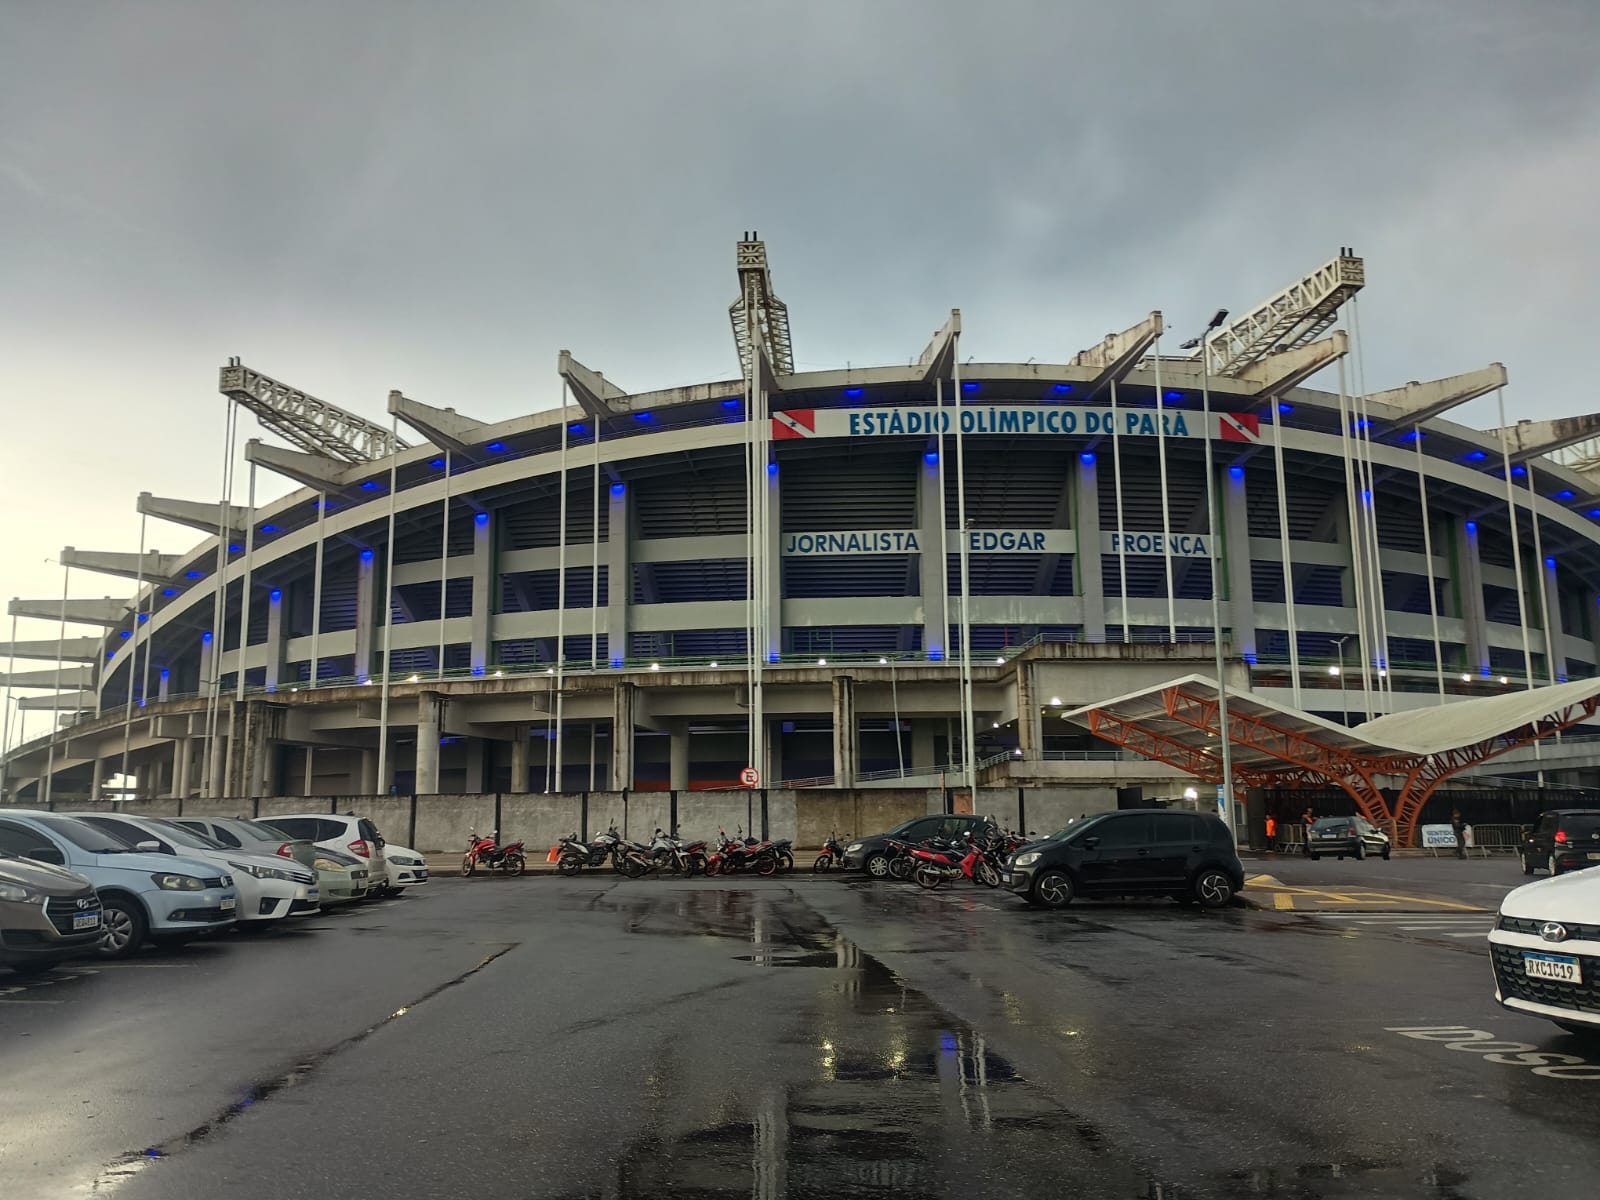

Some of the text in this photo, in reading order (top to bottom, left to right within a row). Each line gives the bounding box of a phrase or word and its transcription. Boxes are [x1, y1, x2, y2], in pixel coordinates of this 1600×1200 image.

[849, 407, 1189, 436] ESTÁDIO OLÍMPICO DO PARÁ
[786, 531, 1208, 556] JORNALISTA EDGAR PROENÇA
[1528, 959, 1574, 980] RXC1C19
